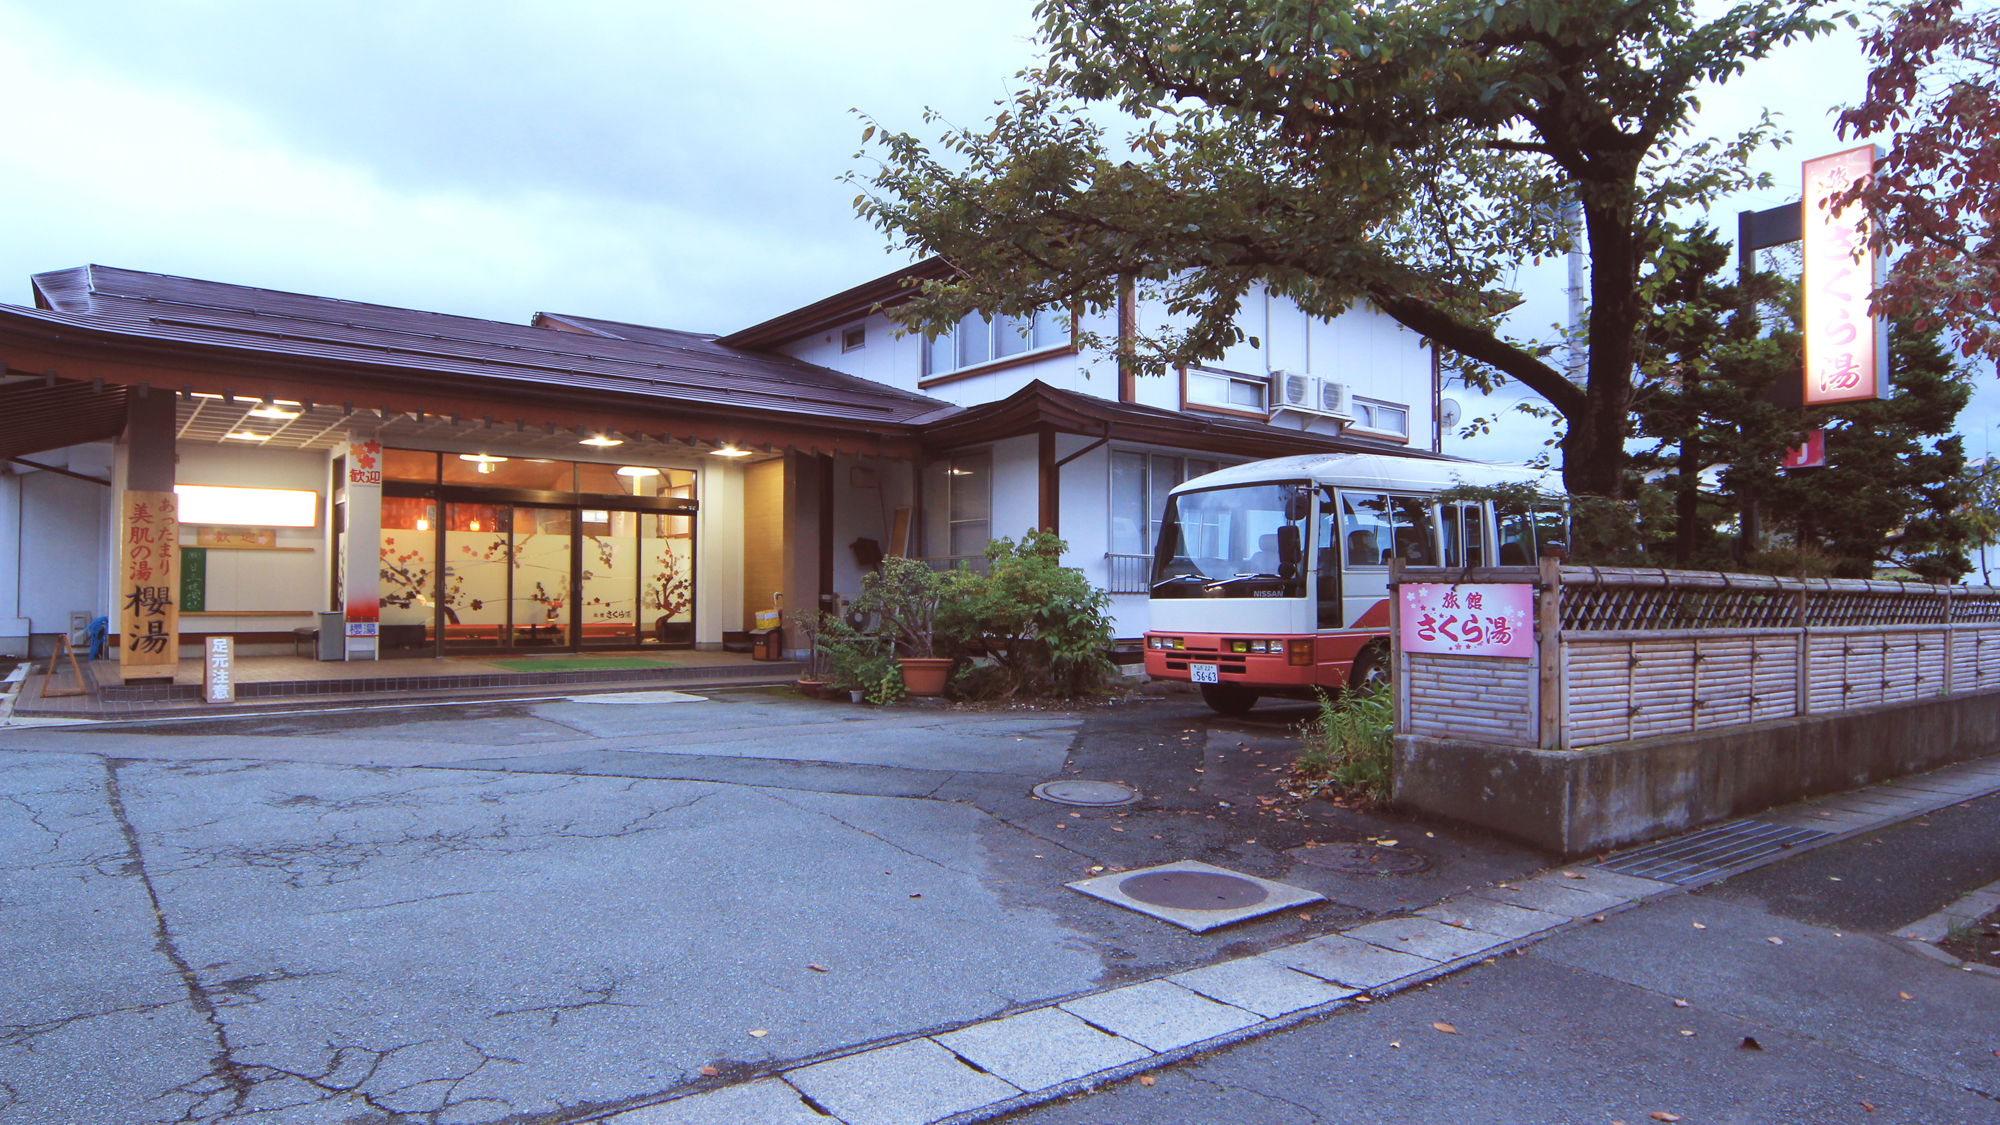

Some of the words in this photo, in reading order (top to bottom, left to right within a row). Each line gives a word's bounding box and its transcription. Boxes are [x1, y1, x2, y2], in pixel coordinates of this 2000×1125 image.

[349, 468, 381, 485] 歓迎
[128, 502, 155, 582] 美肌の湯
[158, 497, 175, 576] あったまり
[1253, 590, 1284, 598] NISSAN
[1441, 591, 1484, 611] 旅館
[123, 584, 173, 654] 櫻湯
[1416, 613, 1513, 645] さくら湯
[211, 638, 230, 700] 足元注意
